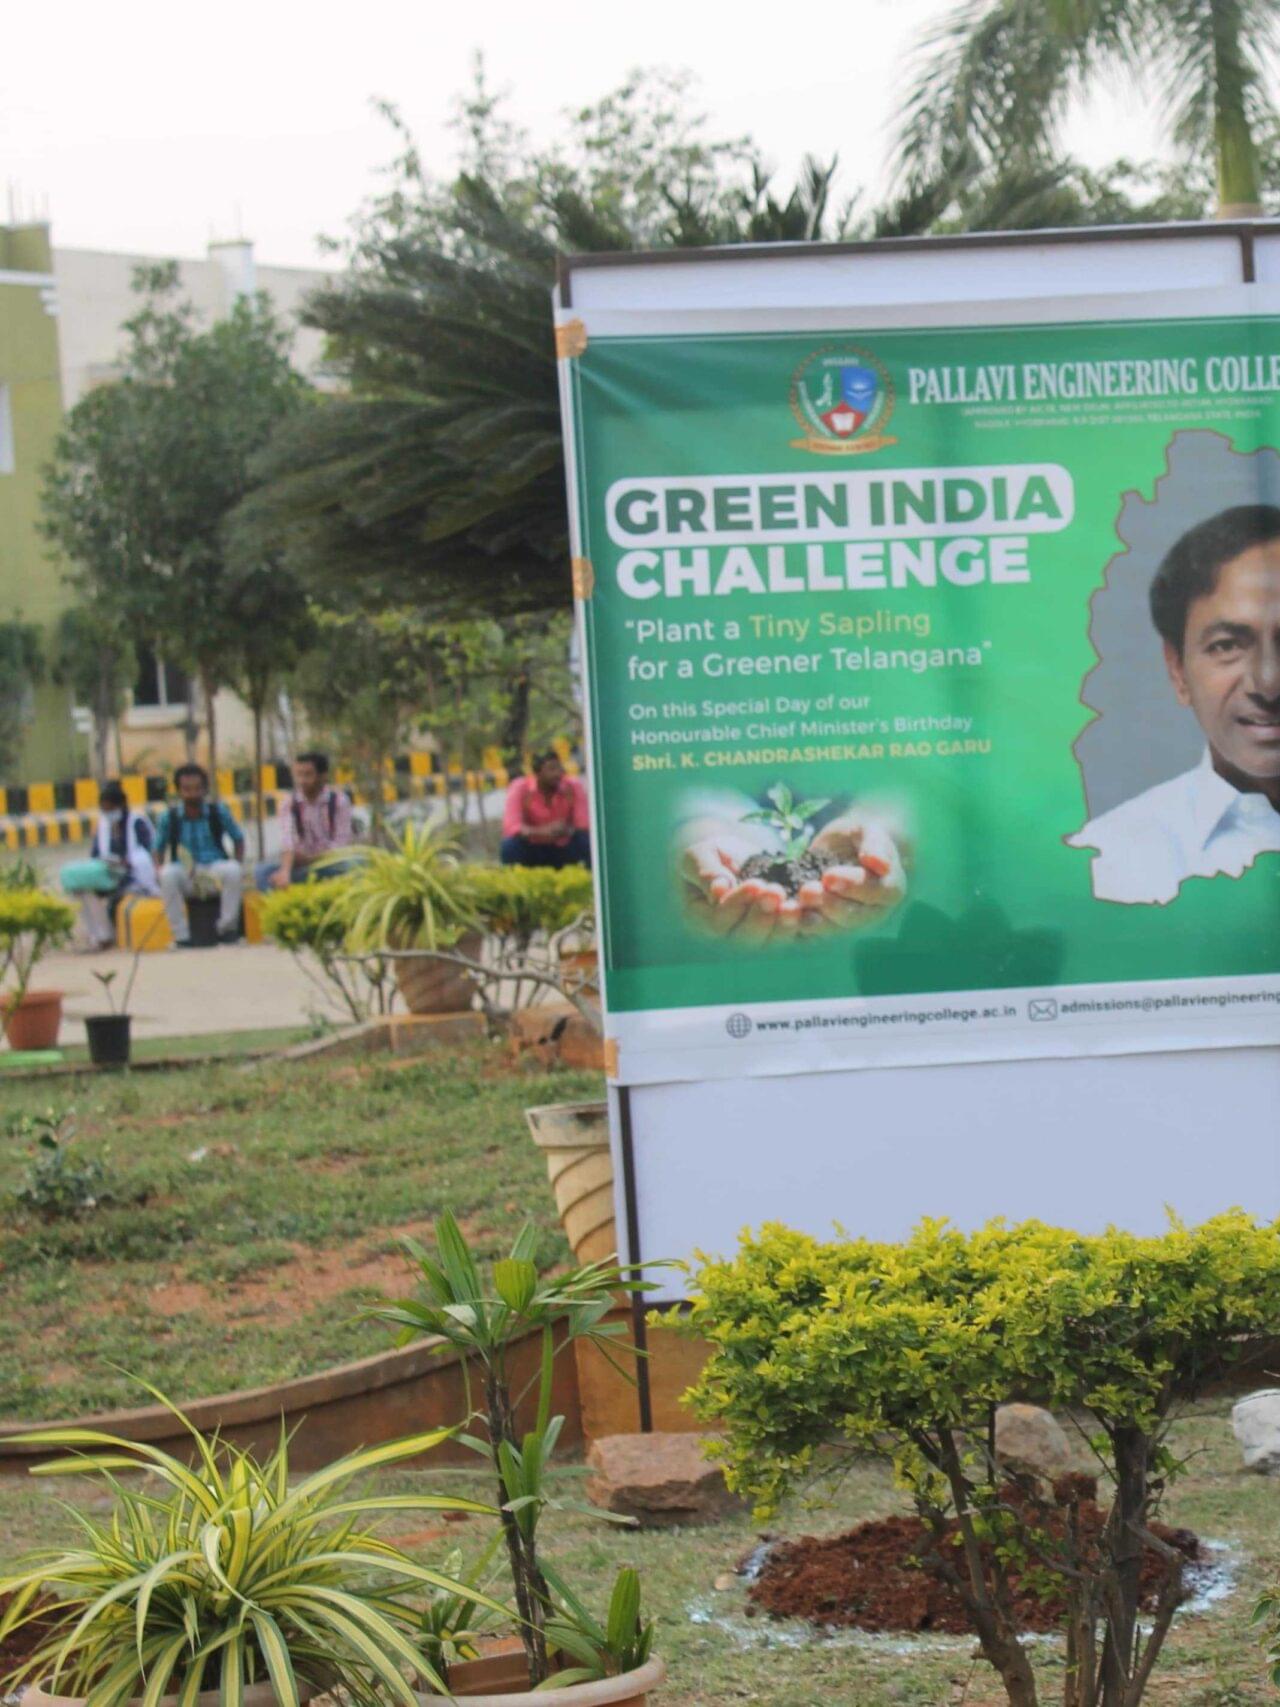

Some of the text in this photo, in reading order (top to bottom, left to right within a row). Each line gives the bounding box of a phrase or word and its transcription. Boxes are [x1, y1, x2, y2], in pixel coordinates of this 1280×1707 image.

[909, 365, 1016, 404] PALLAVI
[1023, 358, 1198, 400] ENGINEERING
[614, 476, 1062, 534] GREEN INDIA
[616, 537, 1031, 600] CHALLENGE
[724, 620, 740, 639] a
[749, 615, 810, 642] Tiny
[819, 610, 930, 638] Sapling
[628, 655, 668, 680] for
[677, 659, 693, 678] a
[703, 653, 822, 677] Greener
[629, 694, 870, 720] On this Special Day of our
[631, 716, 972, 745] Honourable Chief Minister's Birthday
[632, 739, 992, 770] Shri. K. CHANDRASHEKAR RAO GARU
[756, 1005, 1016, 1031] www.pallaviengineeringcollege.ac.in
